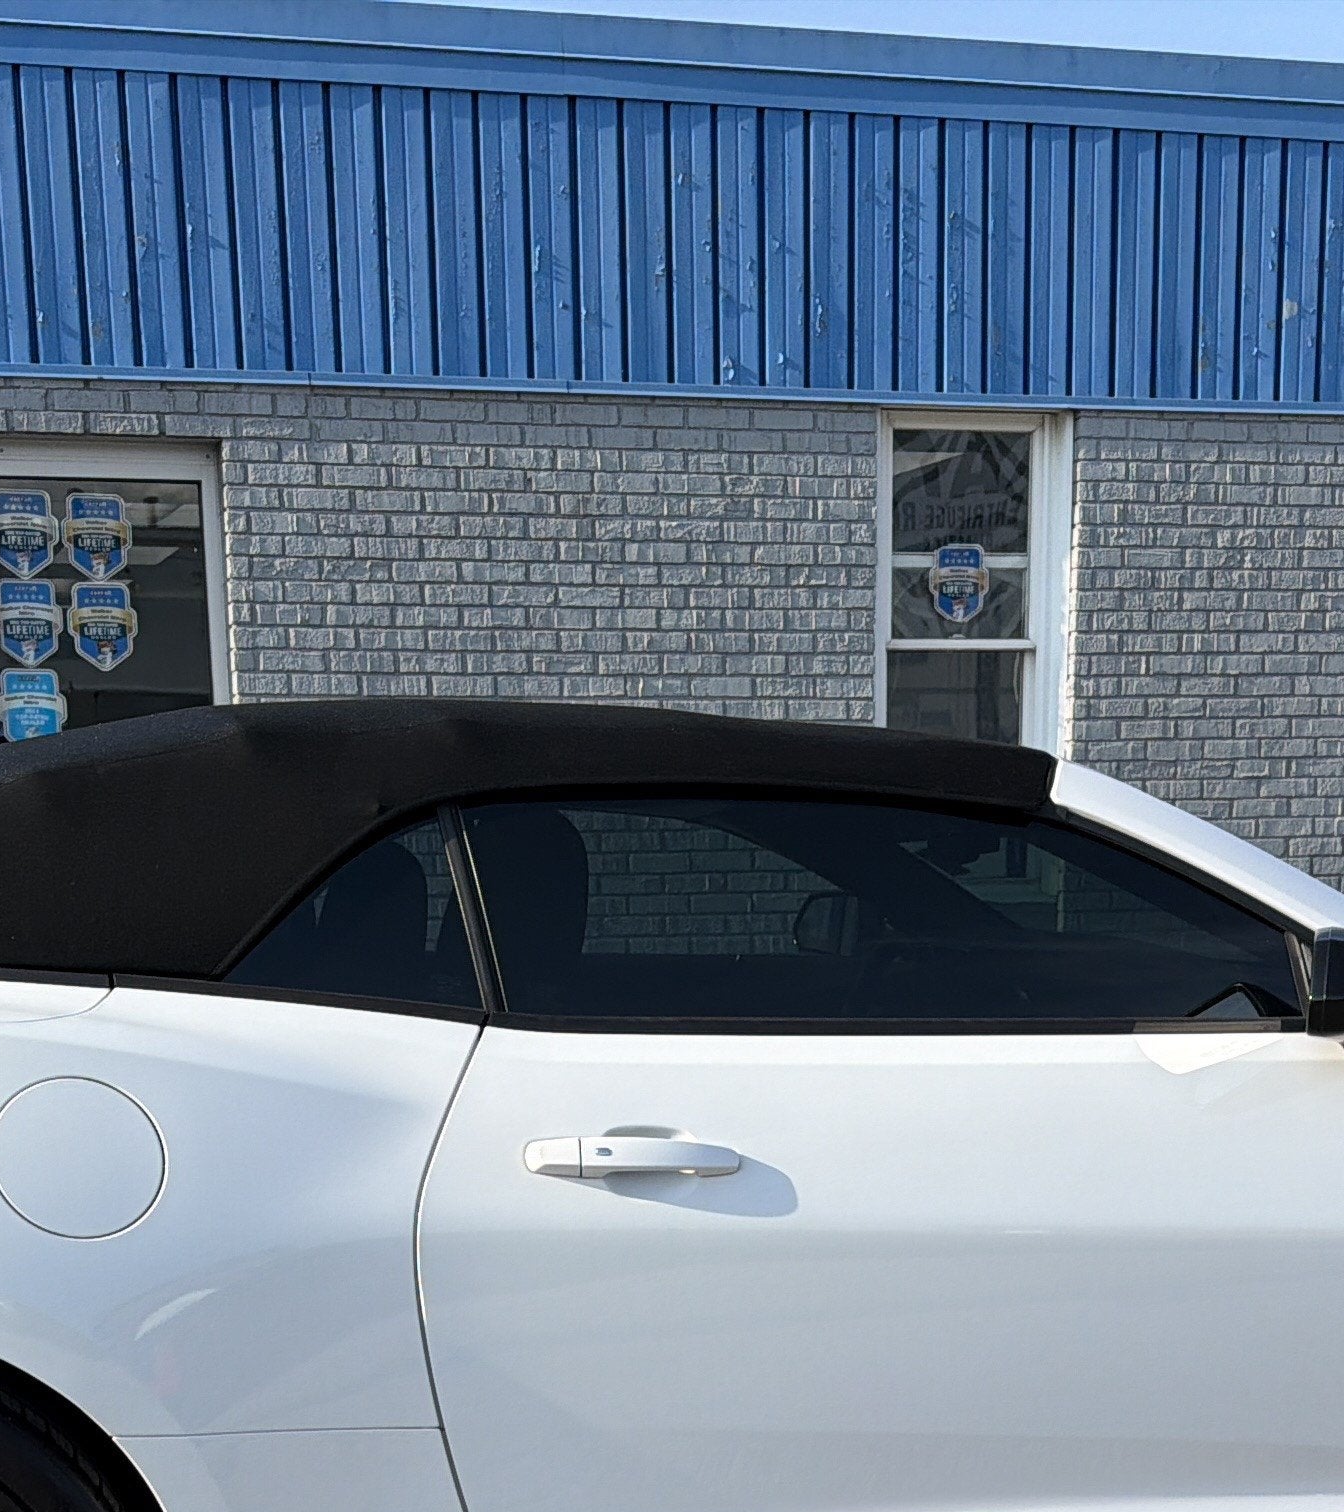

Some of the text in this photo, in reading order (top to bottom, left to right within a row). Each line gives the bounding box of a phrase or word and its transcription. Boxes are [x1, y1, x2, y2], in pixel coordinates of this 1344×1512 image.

[0, 535, 45, 547] LIFETIME
[77, 538, 117, 549] LIFETIME
[6, 625, 50, 636] LIFETIME
[83, 627, 123, 636] LIFETIME
